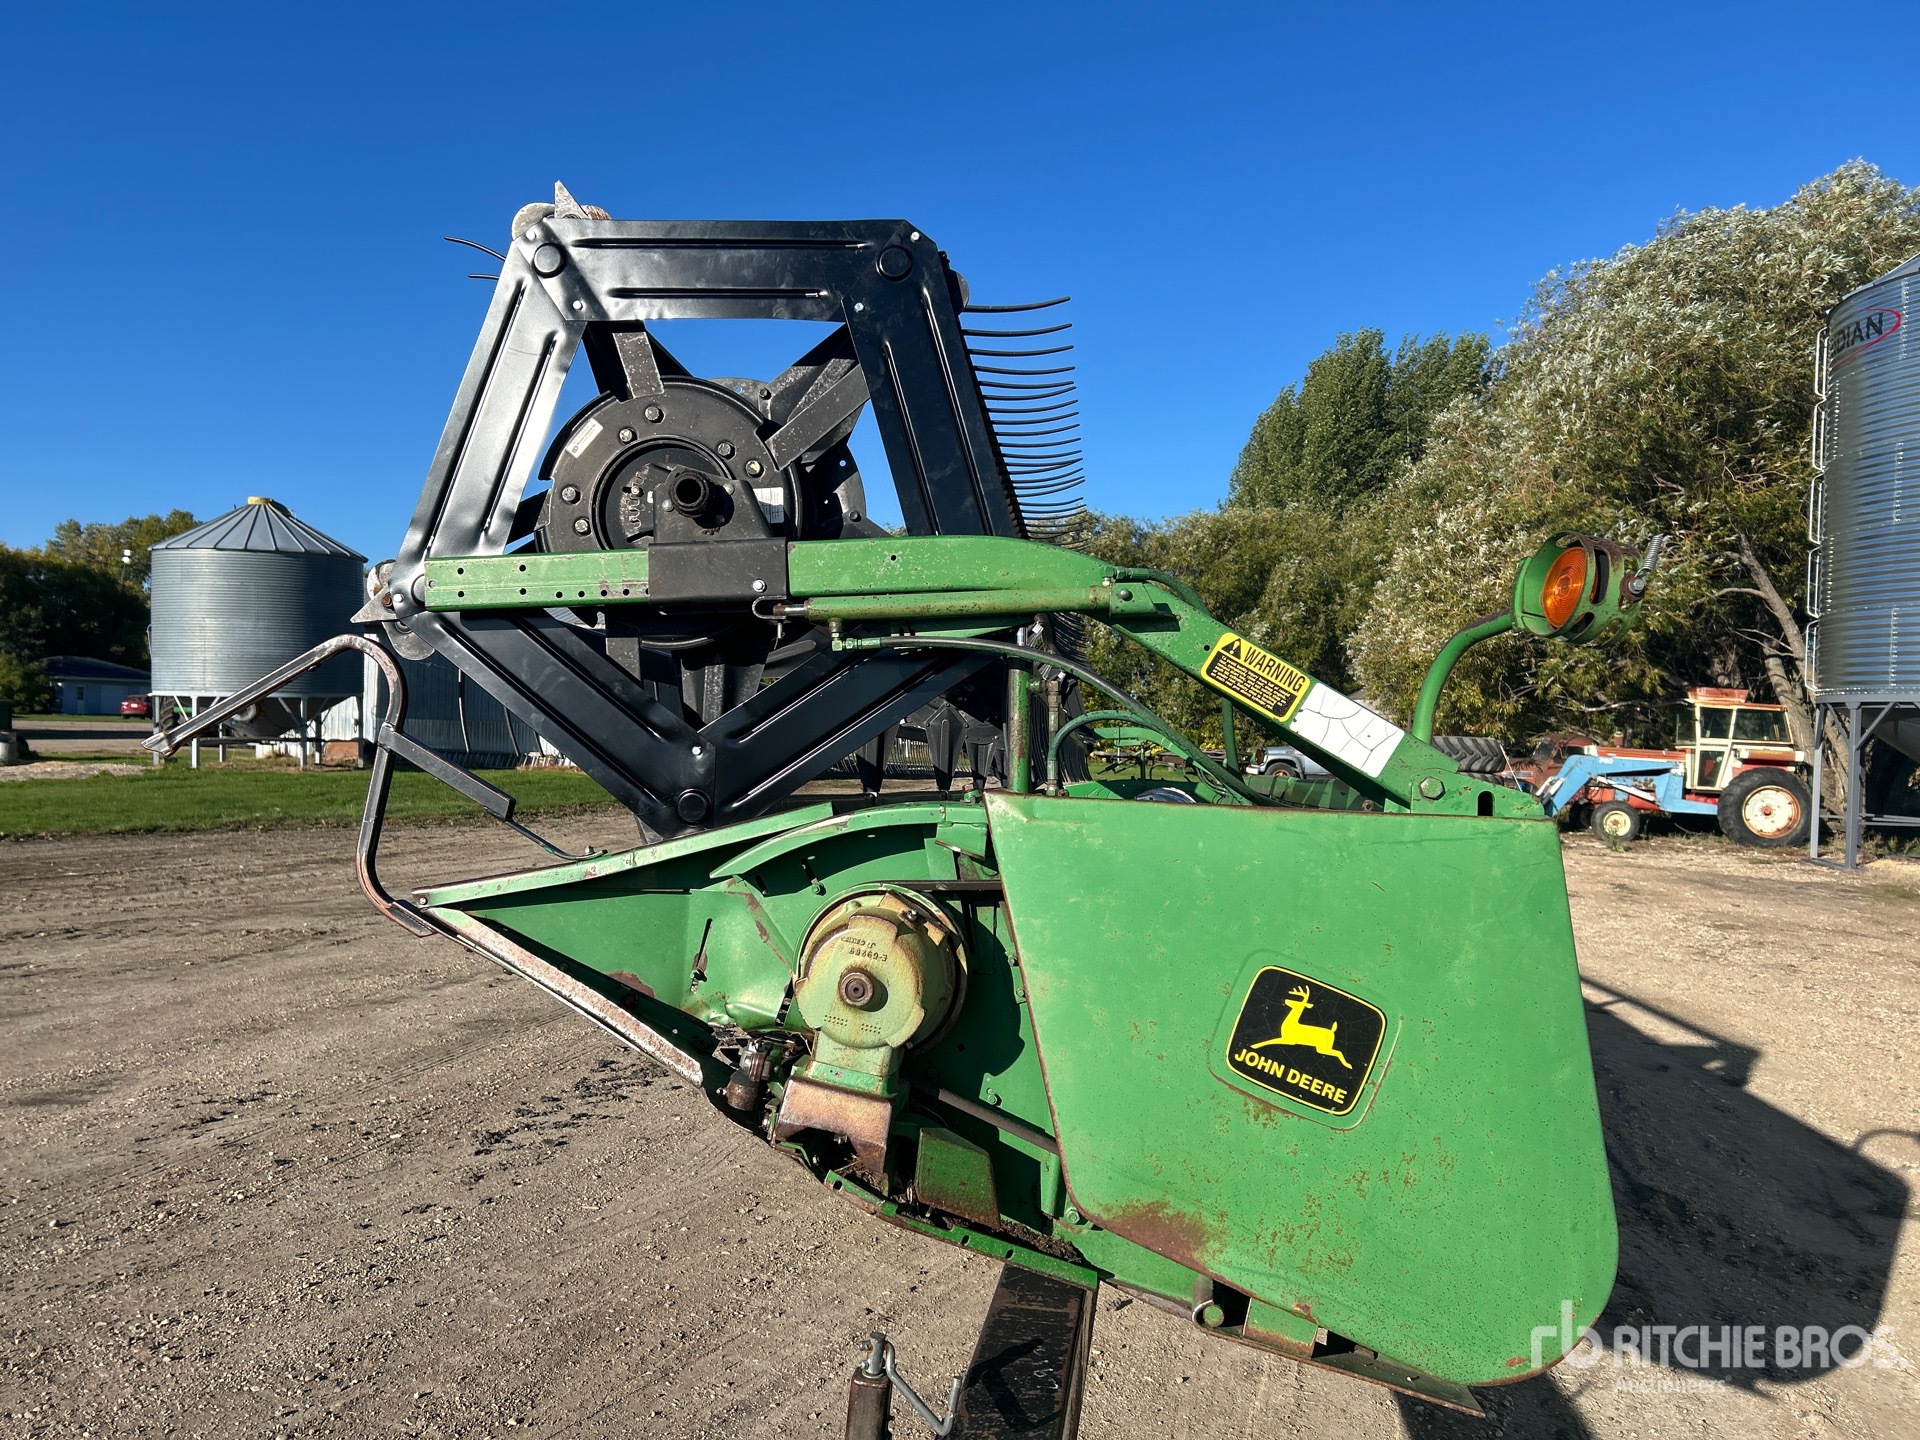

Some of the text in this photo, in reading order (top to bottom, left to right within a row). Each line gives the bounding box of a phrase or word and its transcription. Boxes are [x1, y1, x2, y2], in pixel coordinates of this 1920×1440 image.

[1830, 312, 1884, 356] DIAN
[1244, 646, 1306, 693] WARNING
[1234, 1048, 1348, 1105] JOHN DEERE
